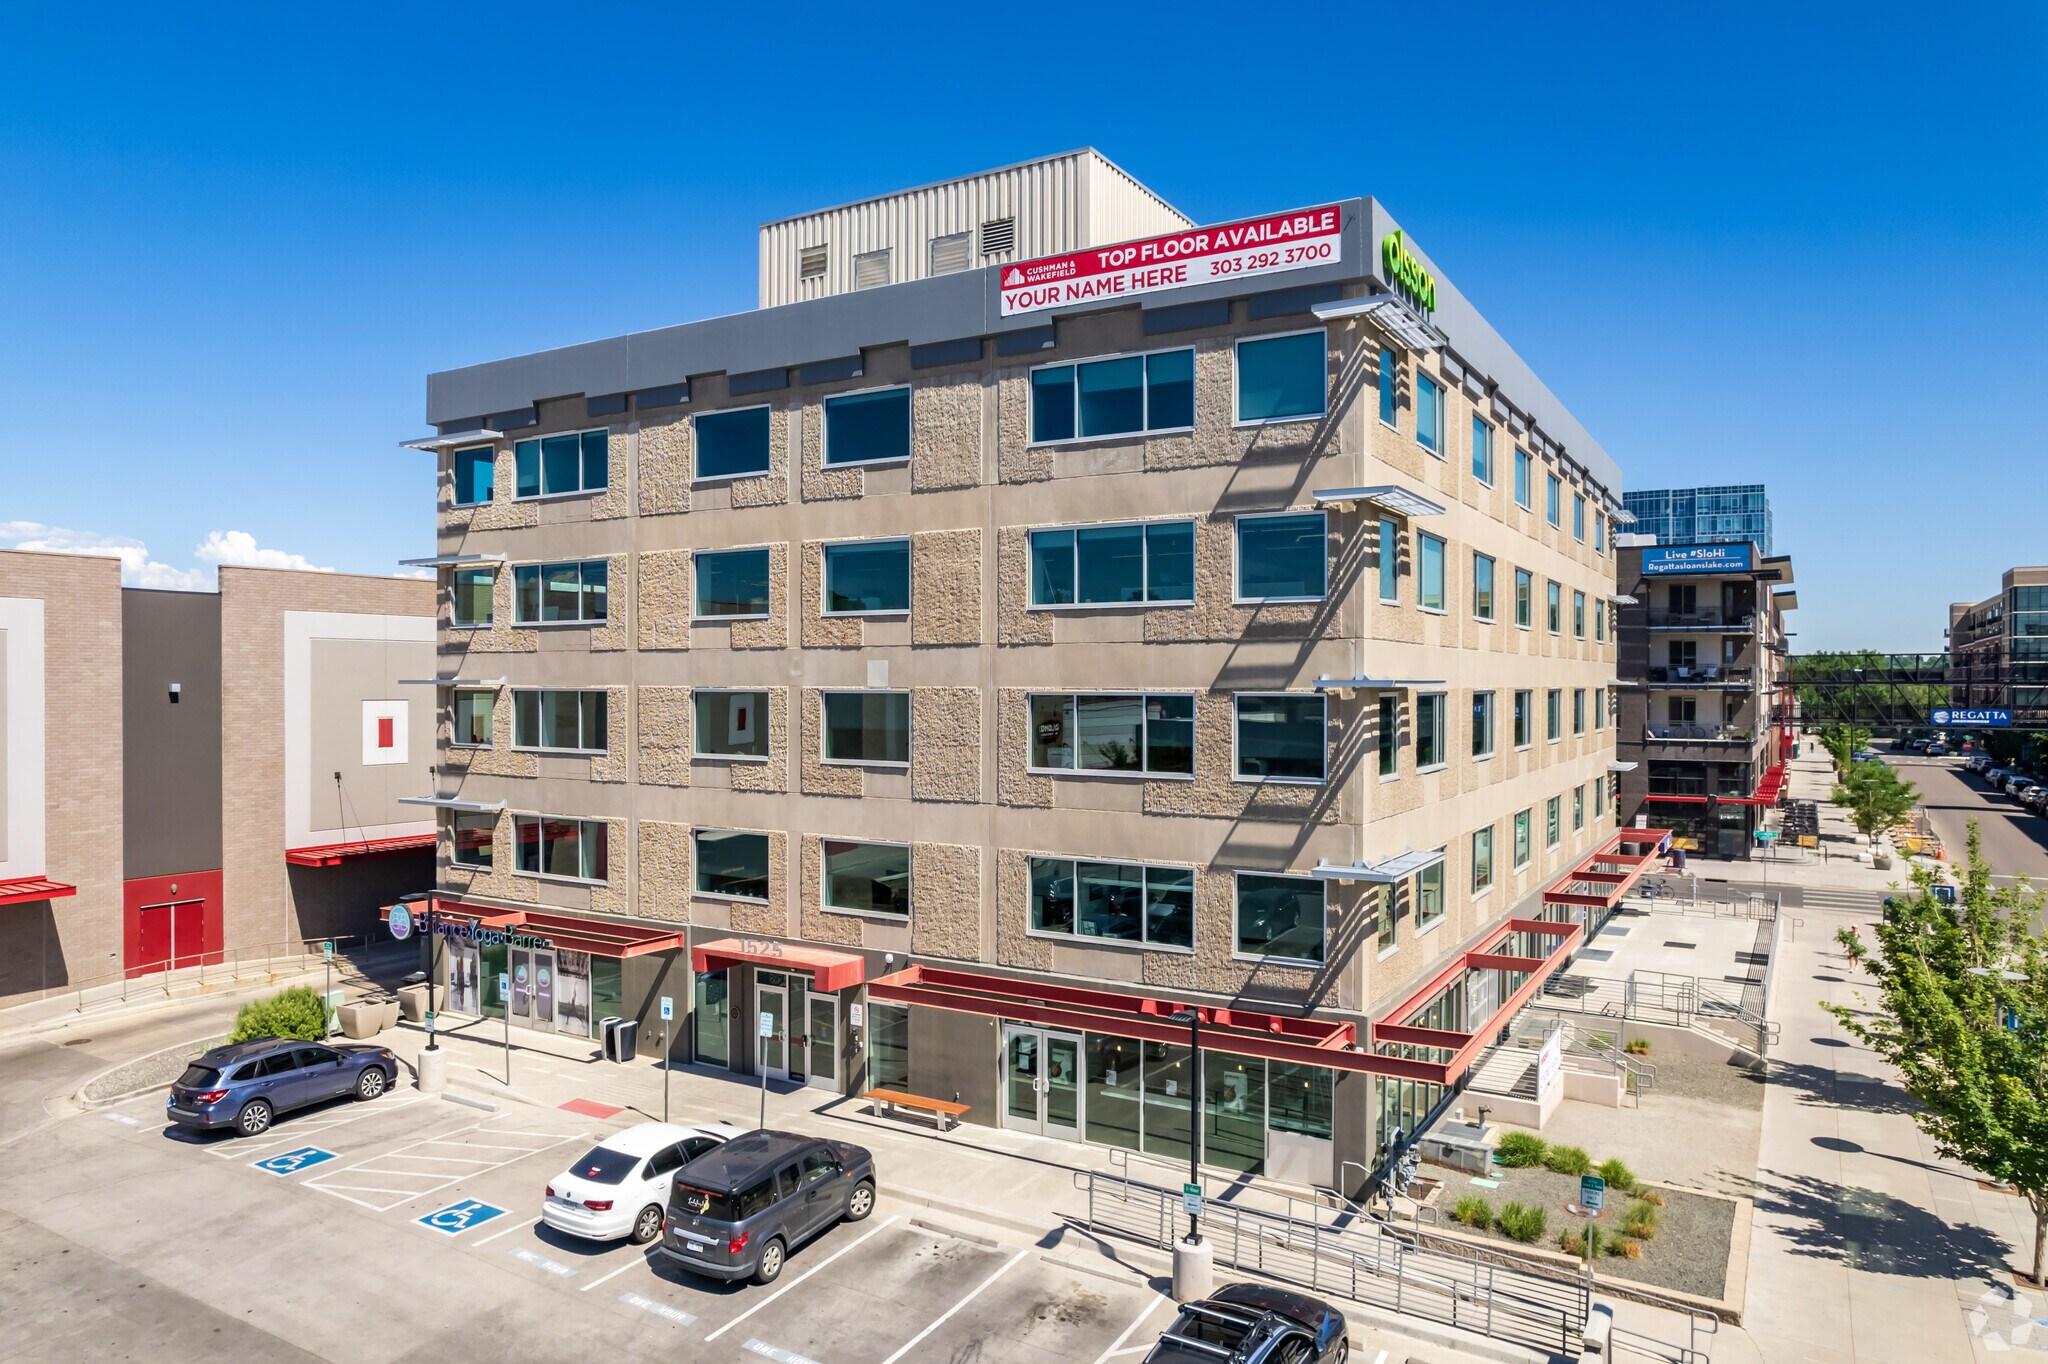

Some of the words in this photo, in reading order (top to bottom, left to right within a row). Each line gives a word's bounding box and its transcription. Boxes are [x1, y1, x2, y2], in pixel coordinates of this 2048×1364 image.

[1097, 247, 1137, 269] TOP
[1141, 234, 1210, 262] FLOOR
[1213, 212, 1335, 249] AVAILABLE
[1026, 261, 1069, 276] CUSHMAN
[1210, 257, 1243, 276] 303
[1247, 251, 1280, 270] 292
[1284, 242, 1332, 264] 3700
[1027, 267, 1077, 283] WAKEFIELD
[1382, 229, 1437, 312] olsson
[1005, 287, 1061, 310] YOUR
[1065, 275, 1125, 301] NAME
[1131, 264, 1188, 290] HERE
[1665, 550, 1688, 559] Live
[1690, 548, 1726, 558] #SloHi
[1648, 562, 1744, 572] Regattasloanslake.com
[1951, 710, 2008, 720] REGATTA
[418, 911, 468, 939] Blance
[468, 917, 500, 948] Yoga
[504, 924, 542, 951] Barre
[738, 937, 783, 958] 1525
[629, 1296, 653, 1308] ONE
[657, 1306, 687, 1321] HOUR
[752, 1342, 778, 1356] ONE
